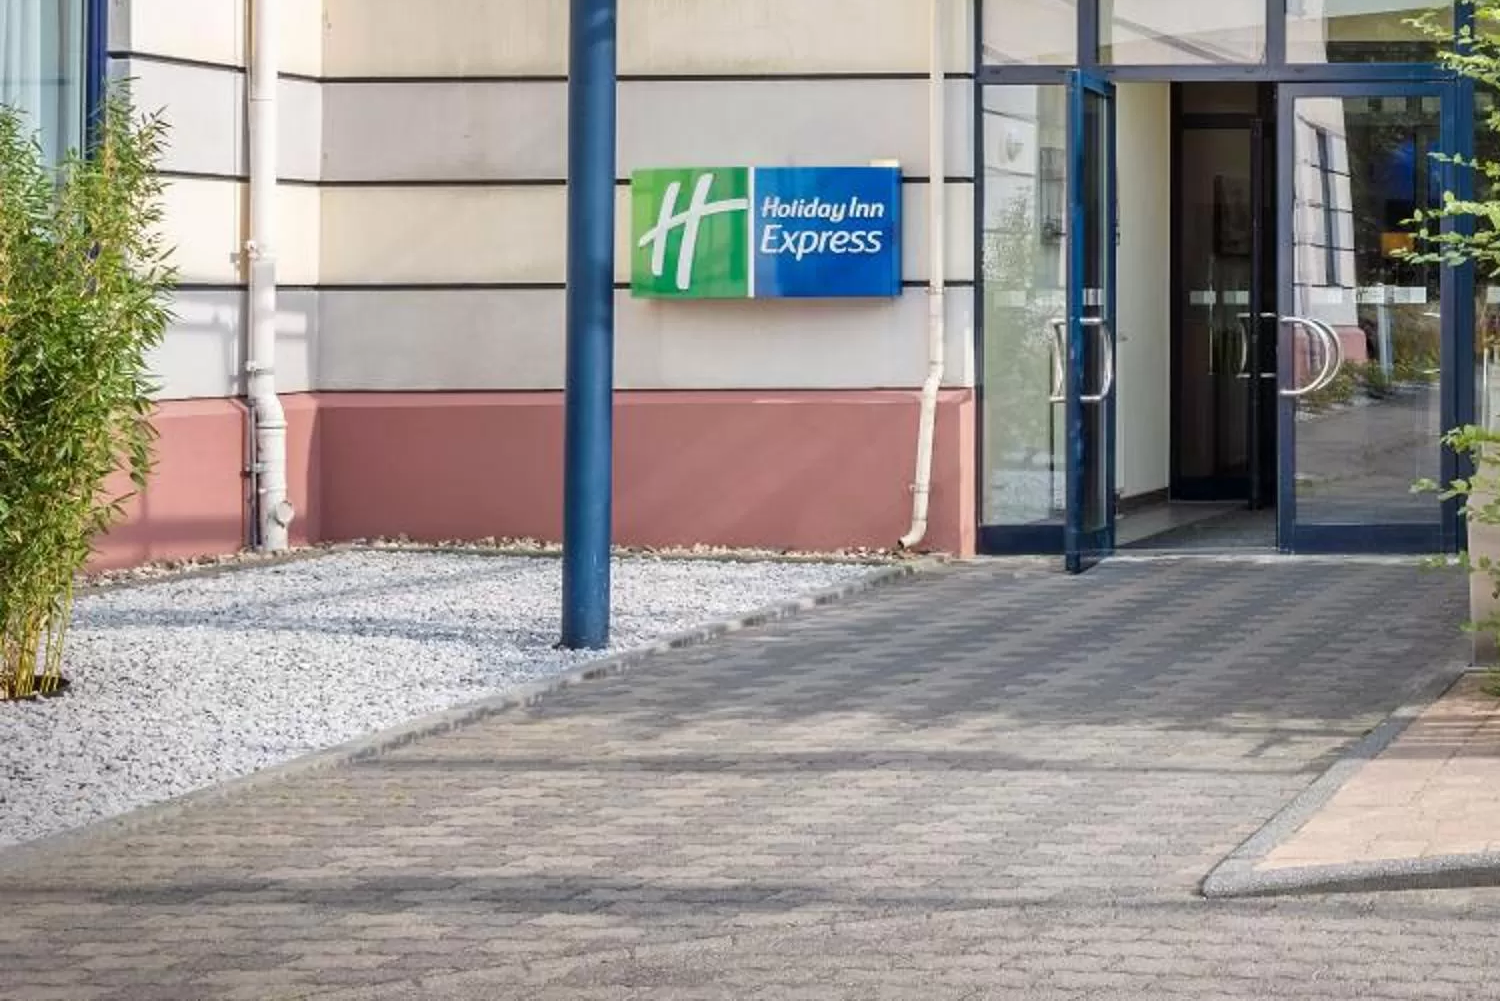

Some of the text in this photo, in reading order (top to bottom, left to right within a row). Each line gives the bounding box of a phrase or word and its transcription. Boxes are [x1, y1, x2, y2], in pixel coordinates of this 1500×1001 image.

[762, 196, 884, 222] Holiday Inn
[638, 173, 748, 290] H
[760, 224, 883, 261] Express
